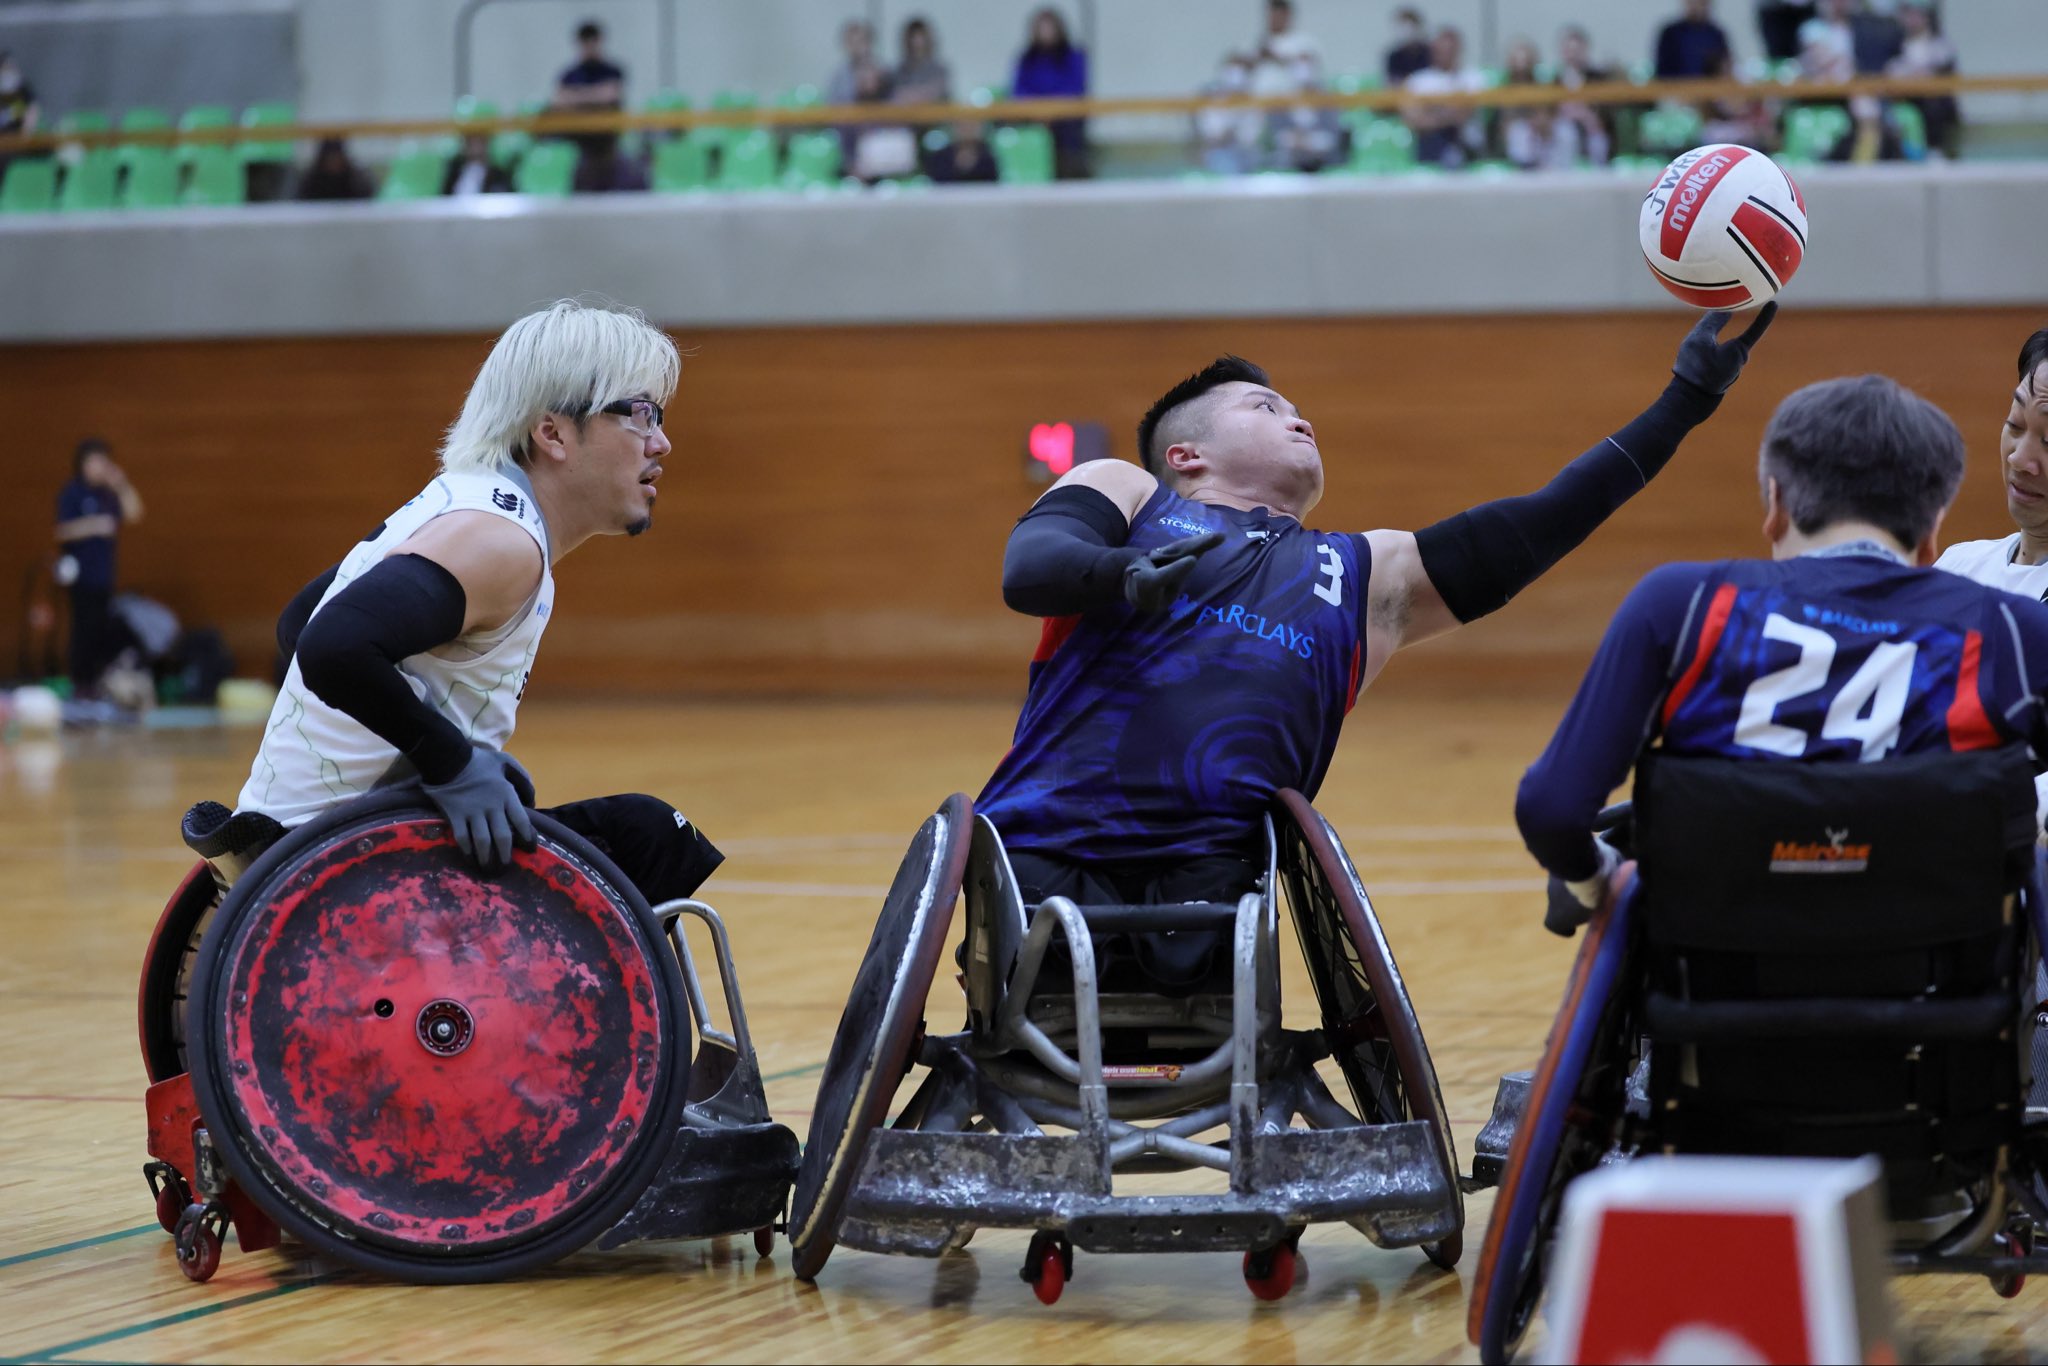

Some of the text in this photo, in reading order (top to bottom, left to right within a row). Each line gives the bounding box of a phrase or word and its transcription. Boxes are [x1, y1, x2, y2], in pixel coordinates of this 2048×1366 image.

[1669, 154, 1732, 232] molten
[1313, 543, 1345, 607] 3
[1733, 612, 1919, 764] 24
